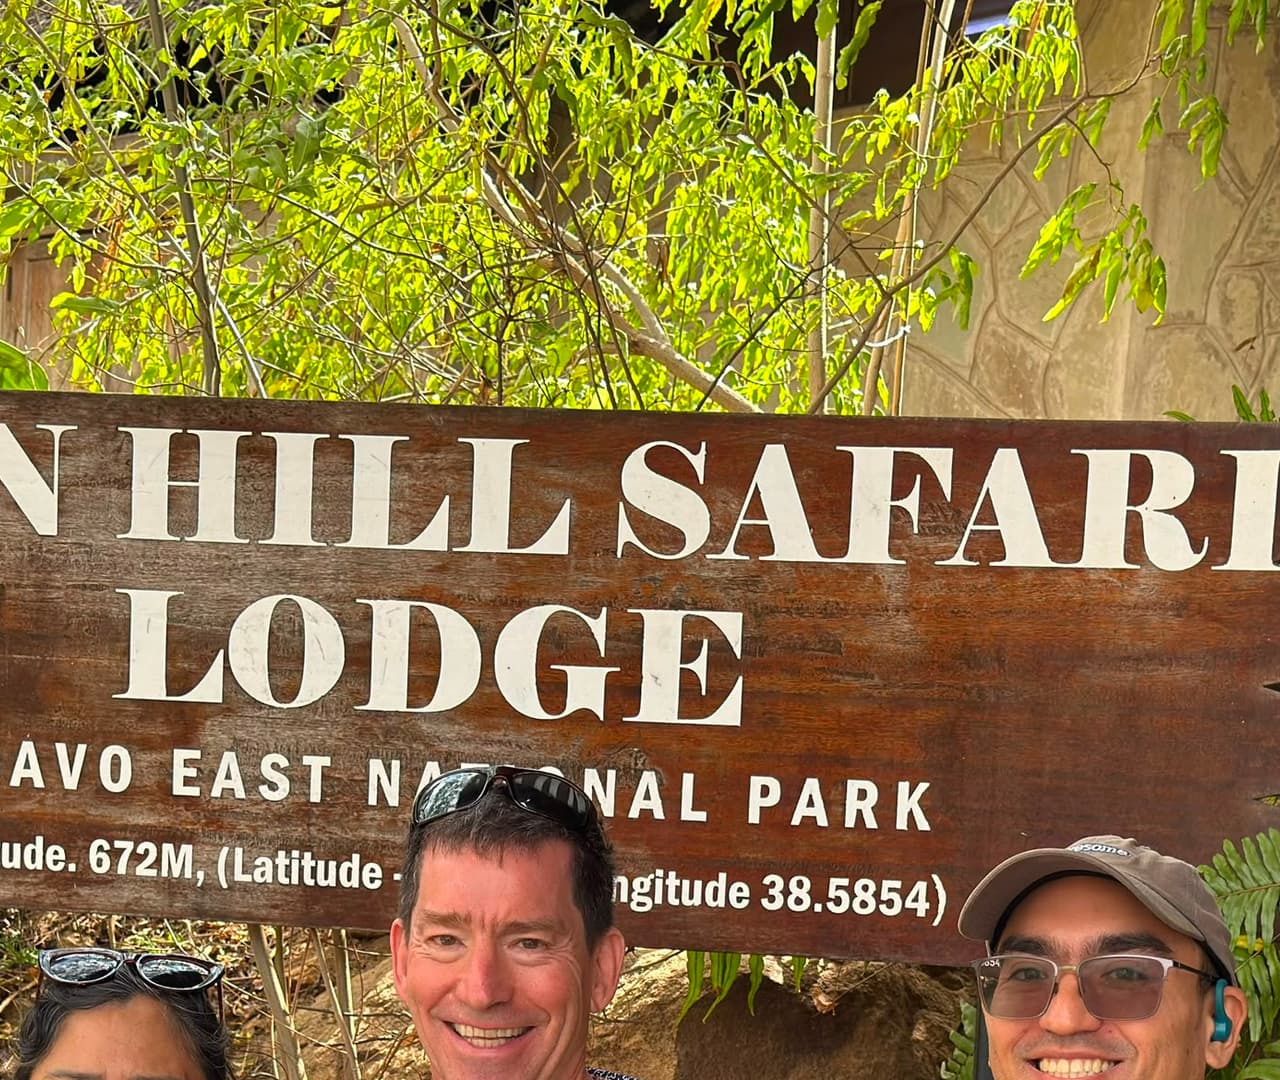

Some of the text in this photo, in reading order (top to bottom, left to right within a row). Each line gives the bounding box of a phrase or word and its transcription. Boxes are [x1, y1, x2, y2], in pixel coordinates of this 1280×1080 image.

[116, 426, 571, 555] HILL
[111, 588, 743, 727] LODGE
[172, 748, 331, 803] EAST
[748, 775, 932, 831] PARK
[88, 838, 205, 887] 672M,
[217, 846, 383, 890] (Latitude
[609, 868, 750, 913] ngitude
[760, 873, 947, 927] 38.5854)
